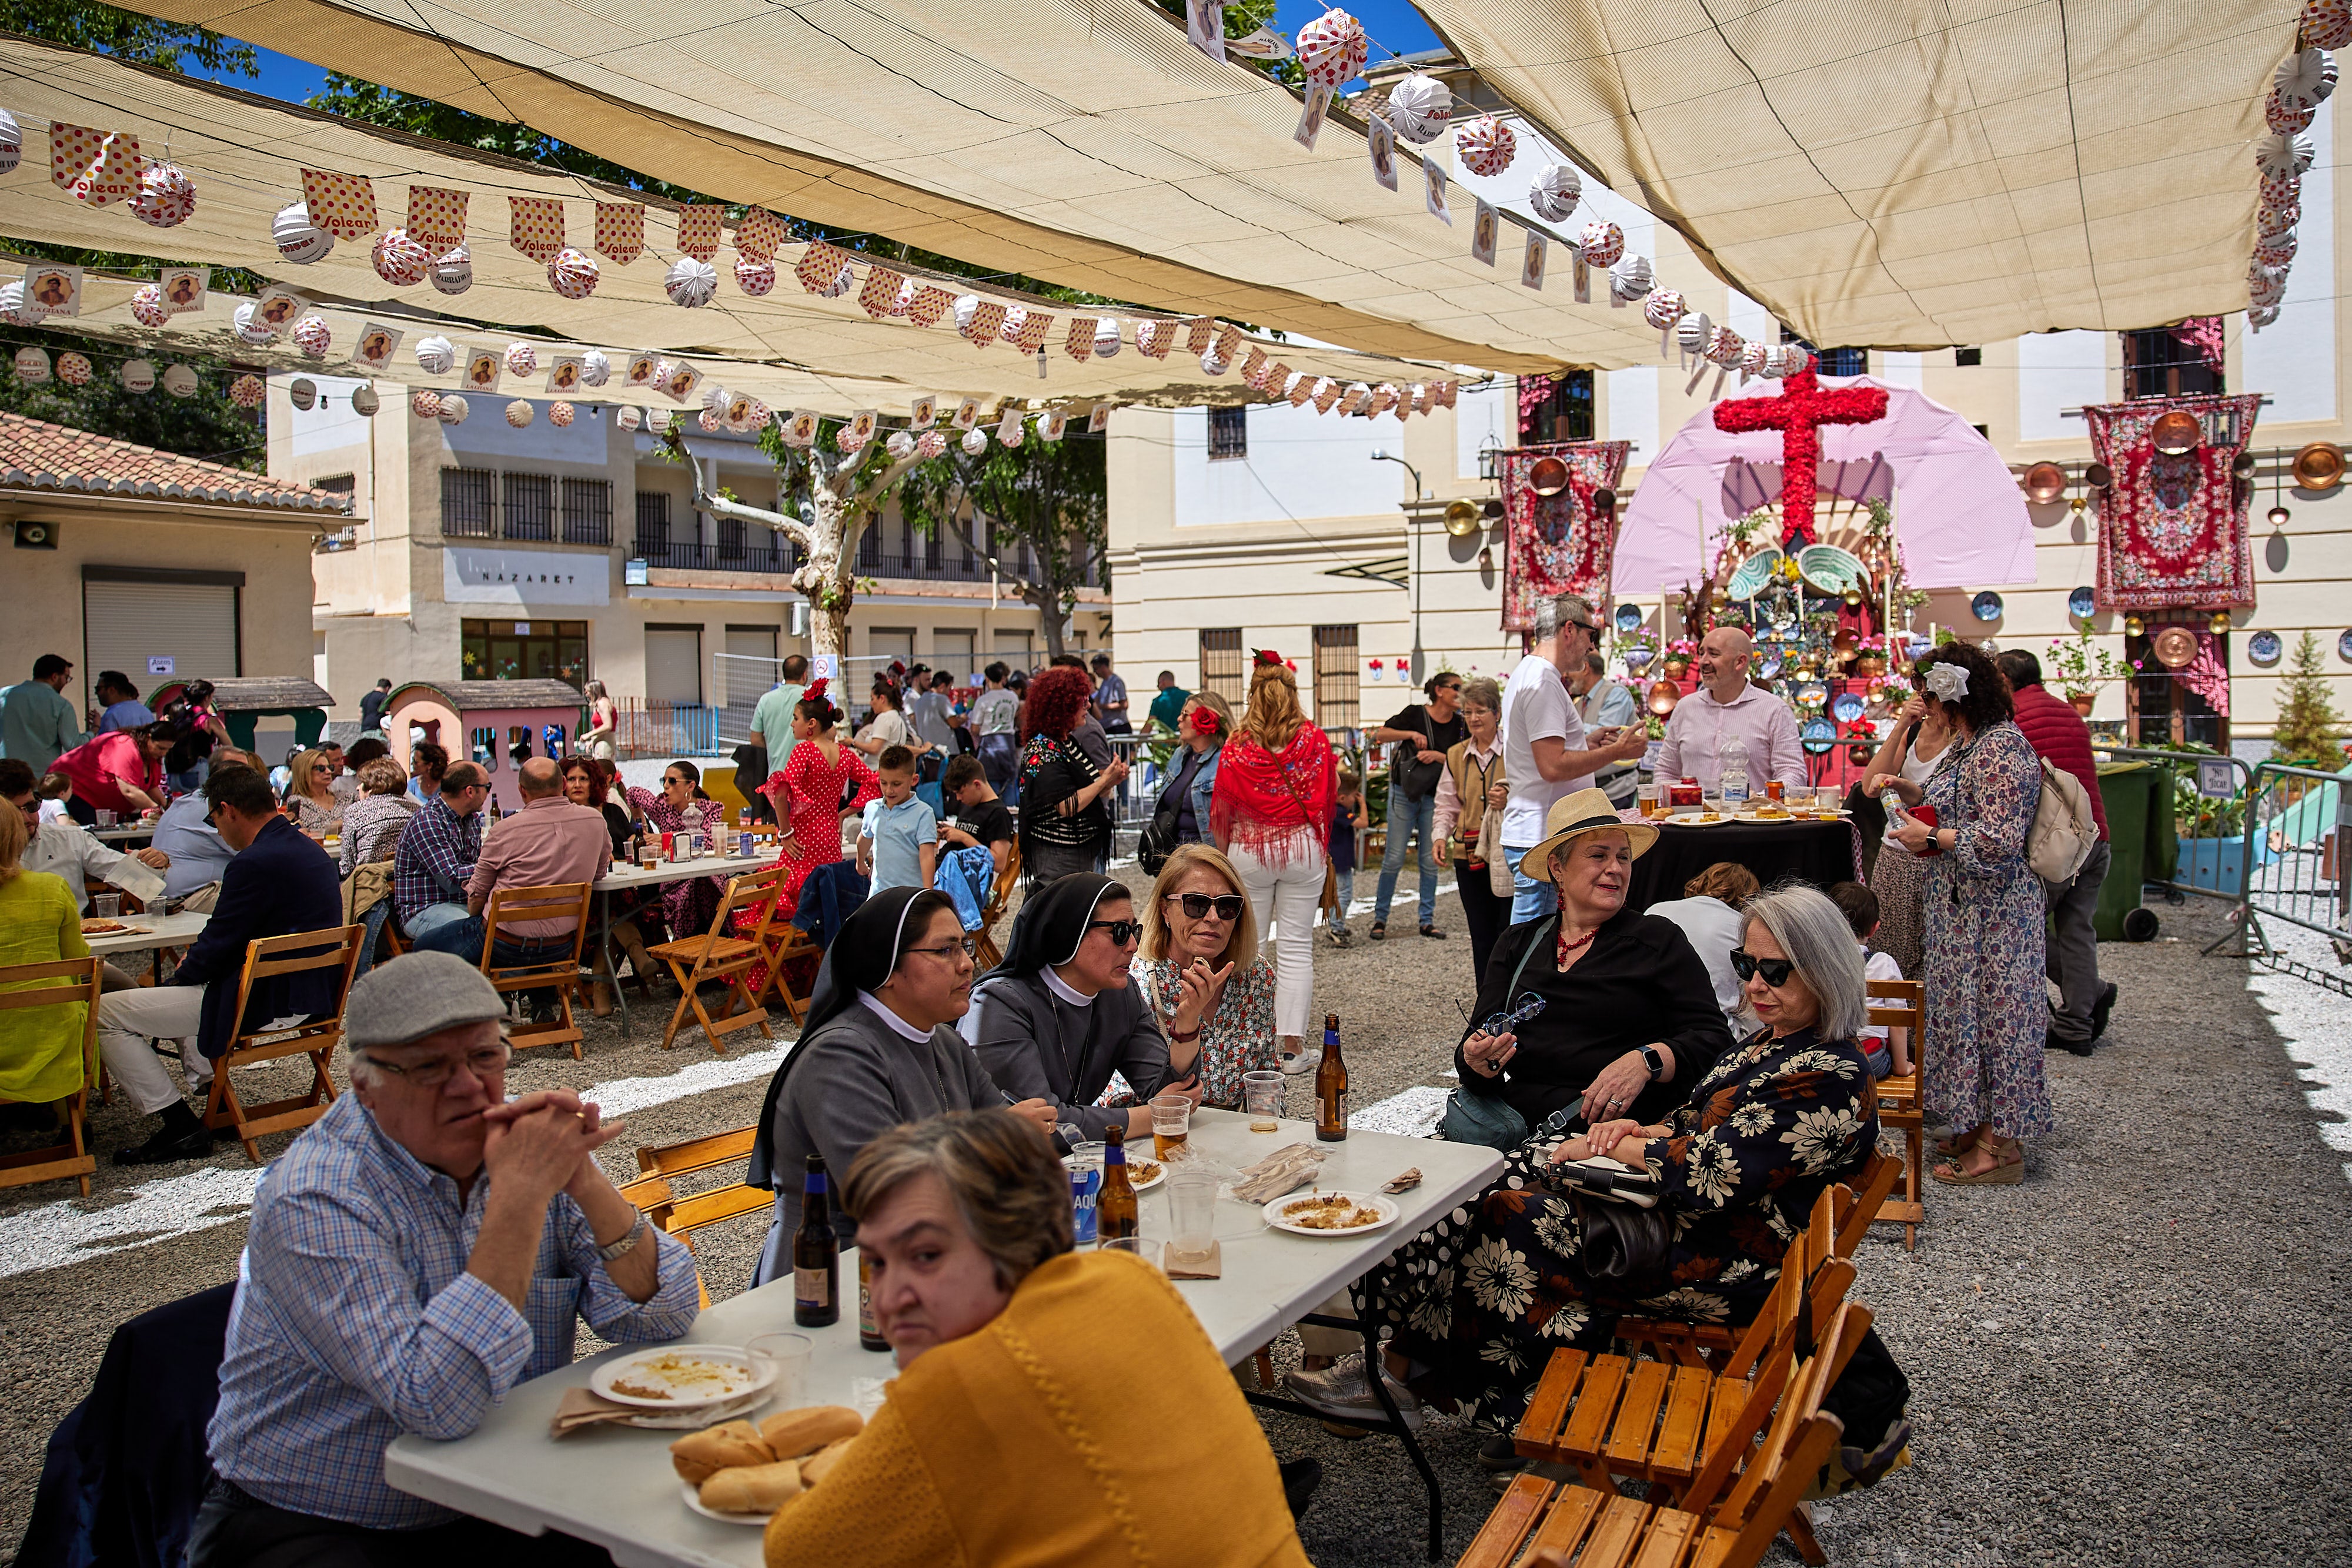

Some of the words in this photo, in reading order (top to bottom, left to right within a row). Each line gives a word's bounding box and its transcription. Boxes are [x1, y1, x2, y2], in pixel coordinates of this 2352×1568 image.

[64, 177, 129, 195] Solear
[320, 215, 371, 228] Solear
[416, 231, 459, 245] Solear
[520, 239, 559, 252] Solear
[603, 243, 639, 254] Solear
[685, 242, 717, 253] Solear
[737, 242, 769, 260] Solear
[37, 269, 72, 278] MANZANILLA
[171, 269, 201, 278] MANZANILLA
[799, 272, 828, 289] Solear
[276, 293, 300, 306] MANZANILLA
[42, 307, 71, 315] GITANA
[863, 299, 890, 313] Solear
[909, 311, 936, 324] Solear
[371, 327, 395, 338] MANZANILLA
[971, 331, 994, 342] Solear
[1019, 340, 1040, 349] Solear
[1070, 347, 1091, 355] Solear
[364, 360, 383, 369] GITANA
[483, 573, 574, 584] NAZARET
[2213, 767, 2223, 777] NO
[2209, 777, 2227, 789] TOCAR
[956, 821, 980, 834] KENZIE
